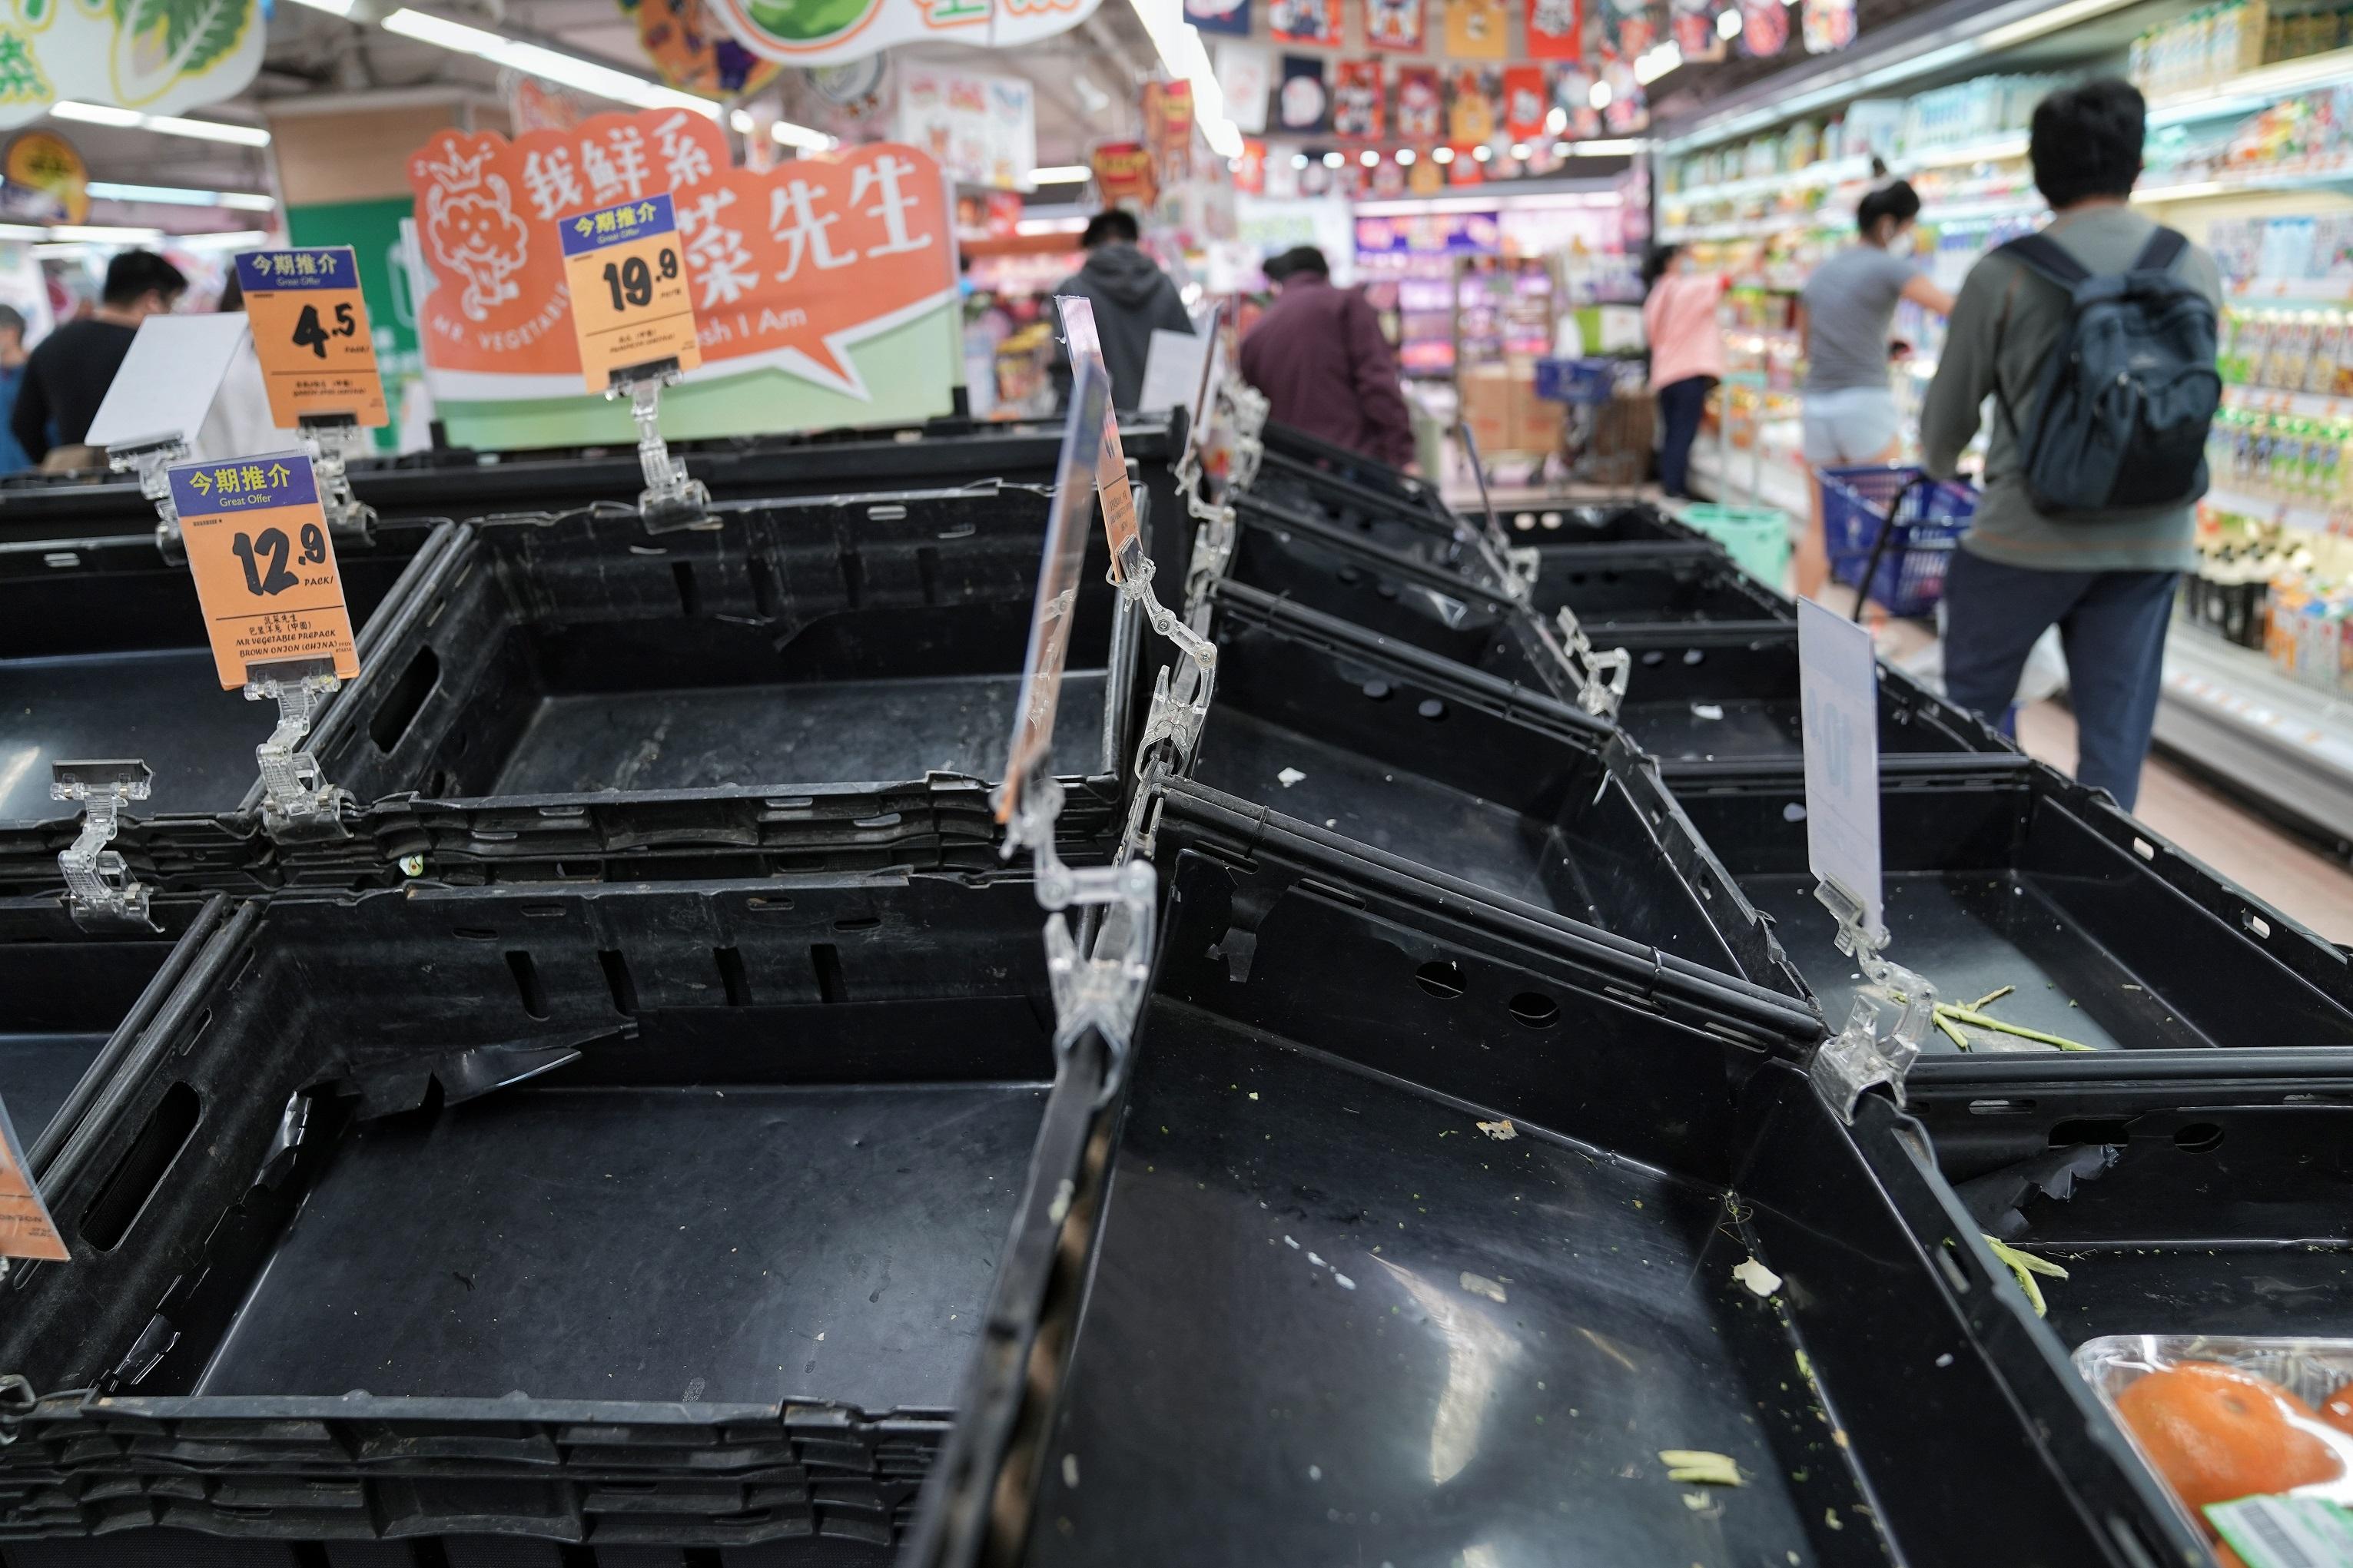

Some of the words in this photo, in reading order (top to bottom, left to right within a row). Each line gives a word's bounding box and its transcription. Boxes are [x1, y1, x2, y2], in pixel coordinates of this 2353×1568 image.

[523, 111, 713, 221] 我鮮系
[574, 201, 657, 238] 今期推介
[675, 154, 934, 309] 菜先生
[251, 252, 338, 277] 今期推介
[603, 248, 679, 311] 19.9
[292, 302, 356, 359] 4.5
[757, 307, 808, 335] Am
[188, 462, 291, 497] 今期推介
[219, 497, 246, 508] Great
[247, 494, 272, 505] Offer
[232, 522, 327, 597] 12.9
[236, 638, 251, 647] MR
[252, 635, 297, 645] VEGETABLE
[298, 629, 336, 640] PREPACK
[240, 648, 269, 658] BROWN
[270, 645, 300, 655] ONION
